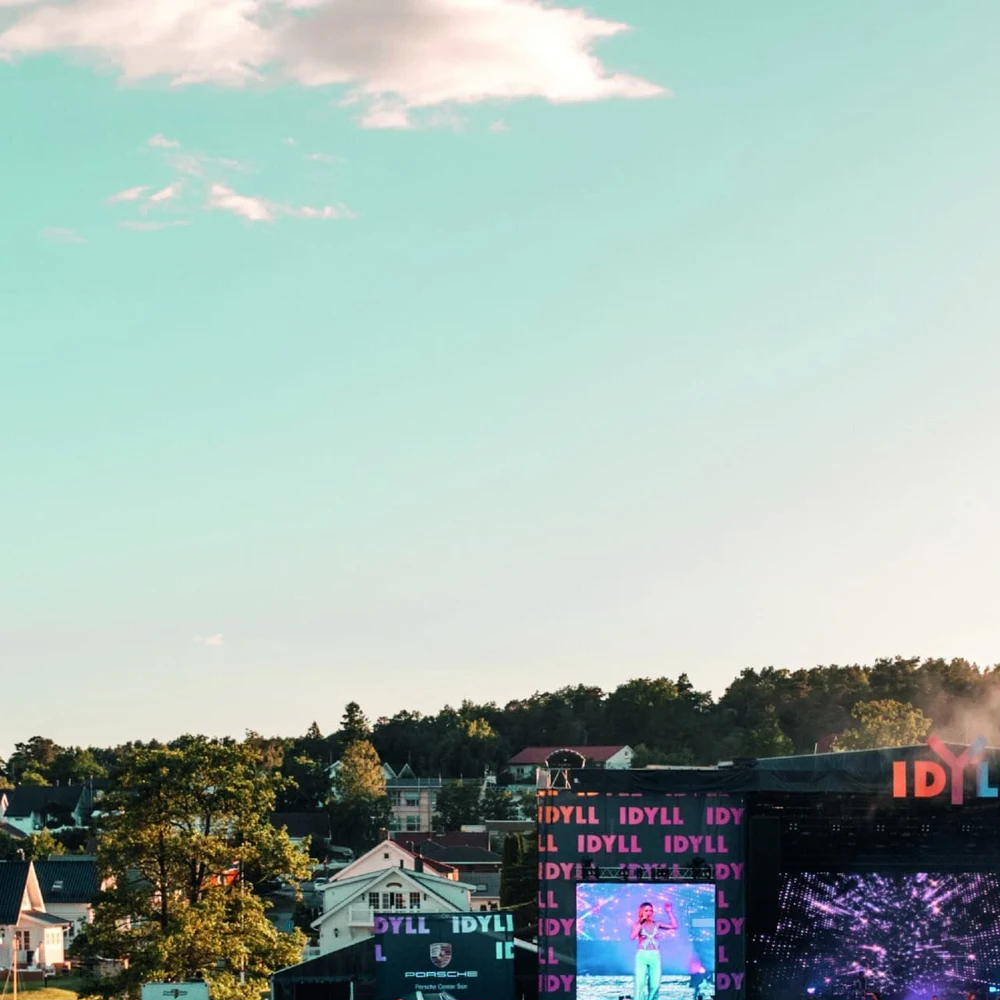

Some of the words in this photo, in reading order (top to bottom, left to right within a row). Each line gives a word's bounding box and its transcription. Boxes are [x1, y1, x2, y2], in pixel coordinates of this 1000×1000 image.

[619, 807, 684, 825] IDYLL
[577, 834, 642, 853] IDYLL
[664, 835, 729, 853] IDYLL
